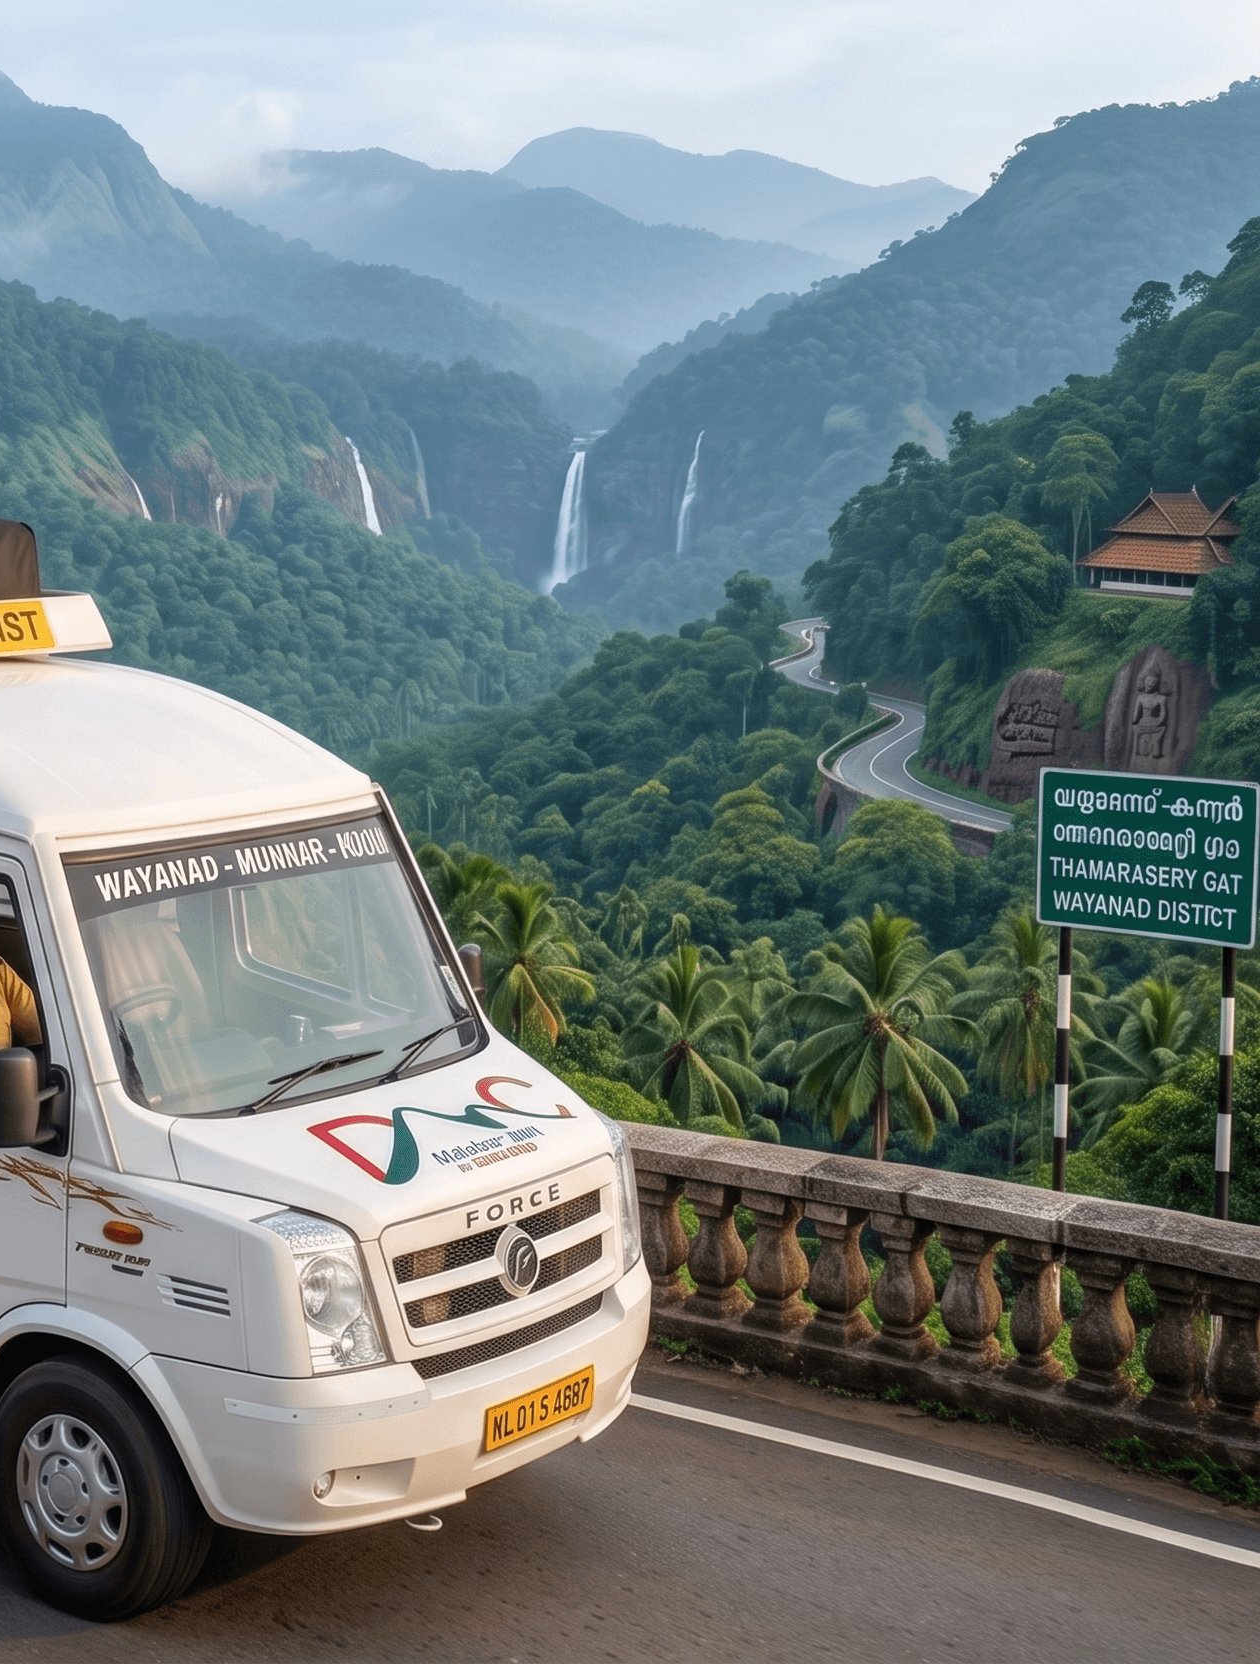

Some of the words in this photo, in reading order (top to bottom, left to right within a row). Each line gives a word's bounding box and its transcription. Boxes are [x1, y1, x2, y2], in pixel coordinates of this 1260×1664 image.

[94, 855, 220, 902] WAYANAD
[234, 837, 329, 876] MUNNAR
[1049, 855, 1198, 890] THAMARASERY
[1202, 870, 1244, 896] GAT
[1053, 889, 1152, 919] WAYANAD
[466, 1182, 561, 1229] FORCE
[492, 1410, 515, 1443] NL
[552, 1376, 591, 1416] 4687
